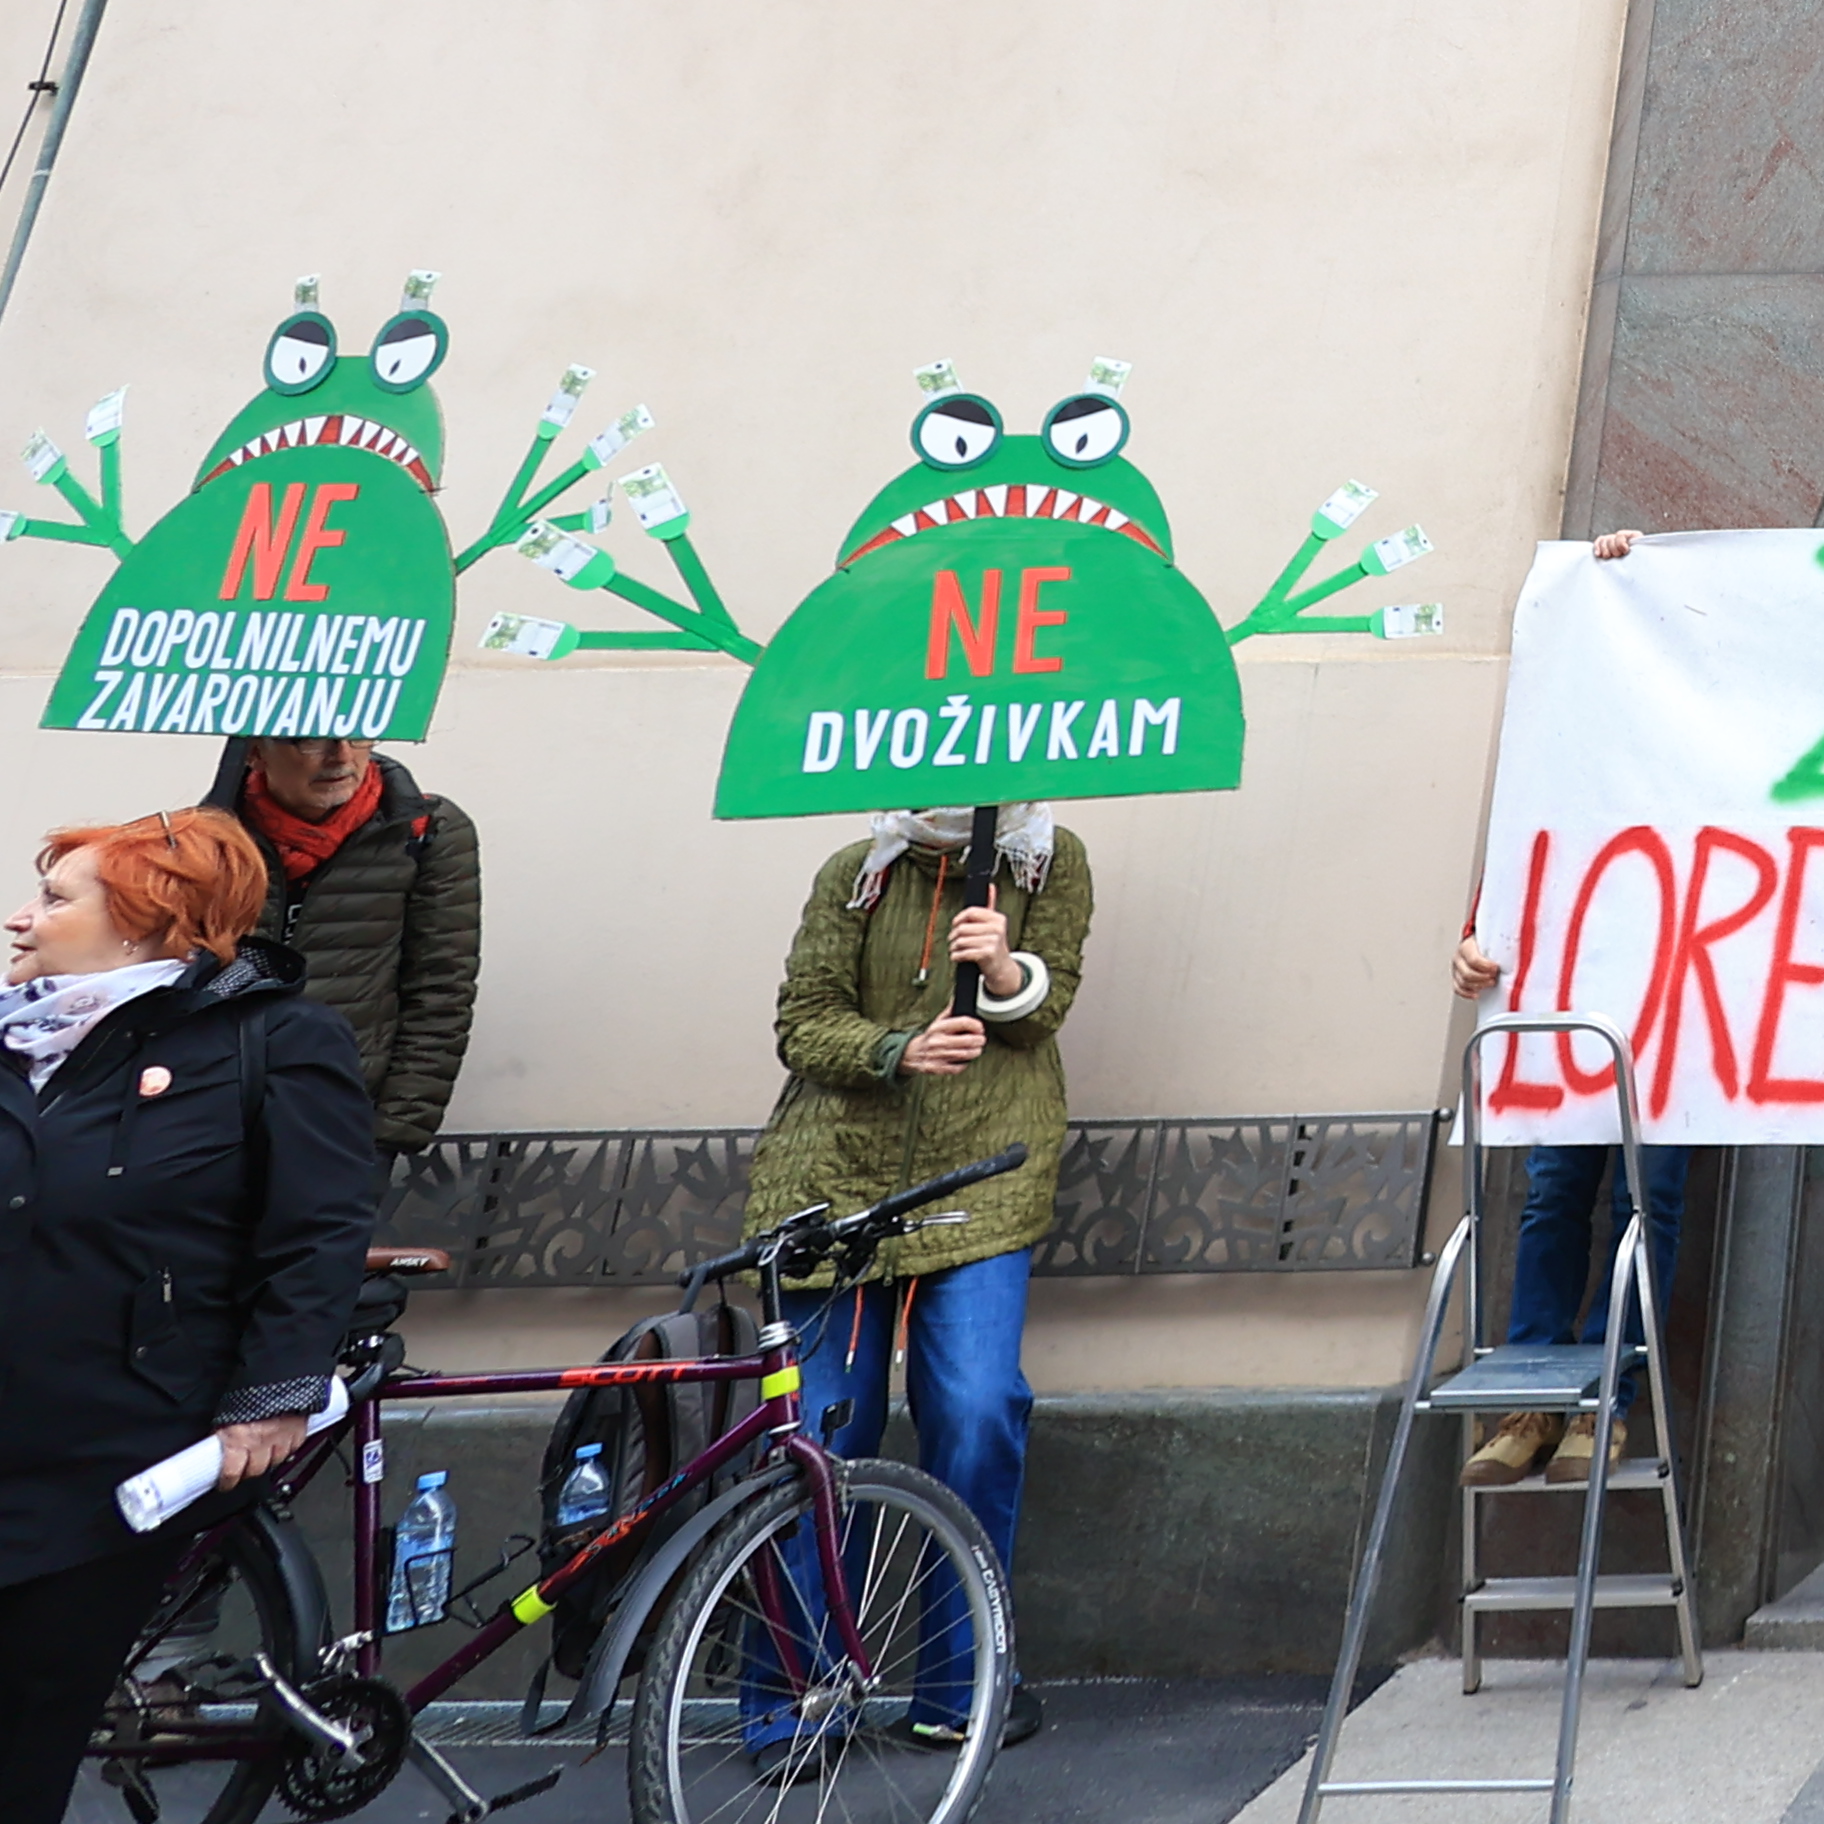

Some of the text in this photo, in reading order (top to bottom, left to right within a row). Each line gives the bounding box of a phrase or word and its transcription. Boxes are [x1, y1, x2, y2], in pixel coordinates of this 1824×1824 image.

[219, 482, 359, 601] NE
[100, 607, 427, 678] DOPOLNILNEMU
[924, 566, 1071, 680] NE
[76, 669, 403, 738] ZAVAROVANJU
[803, 694, 1182, 774] DVOŽIVKAM
[559, 1362, 697, 1388] SCOTT
